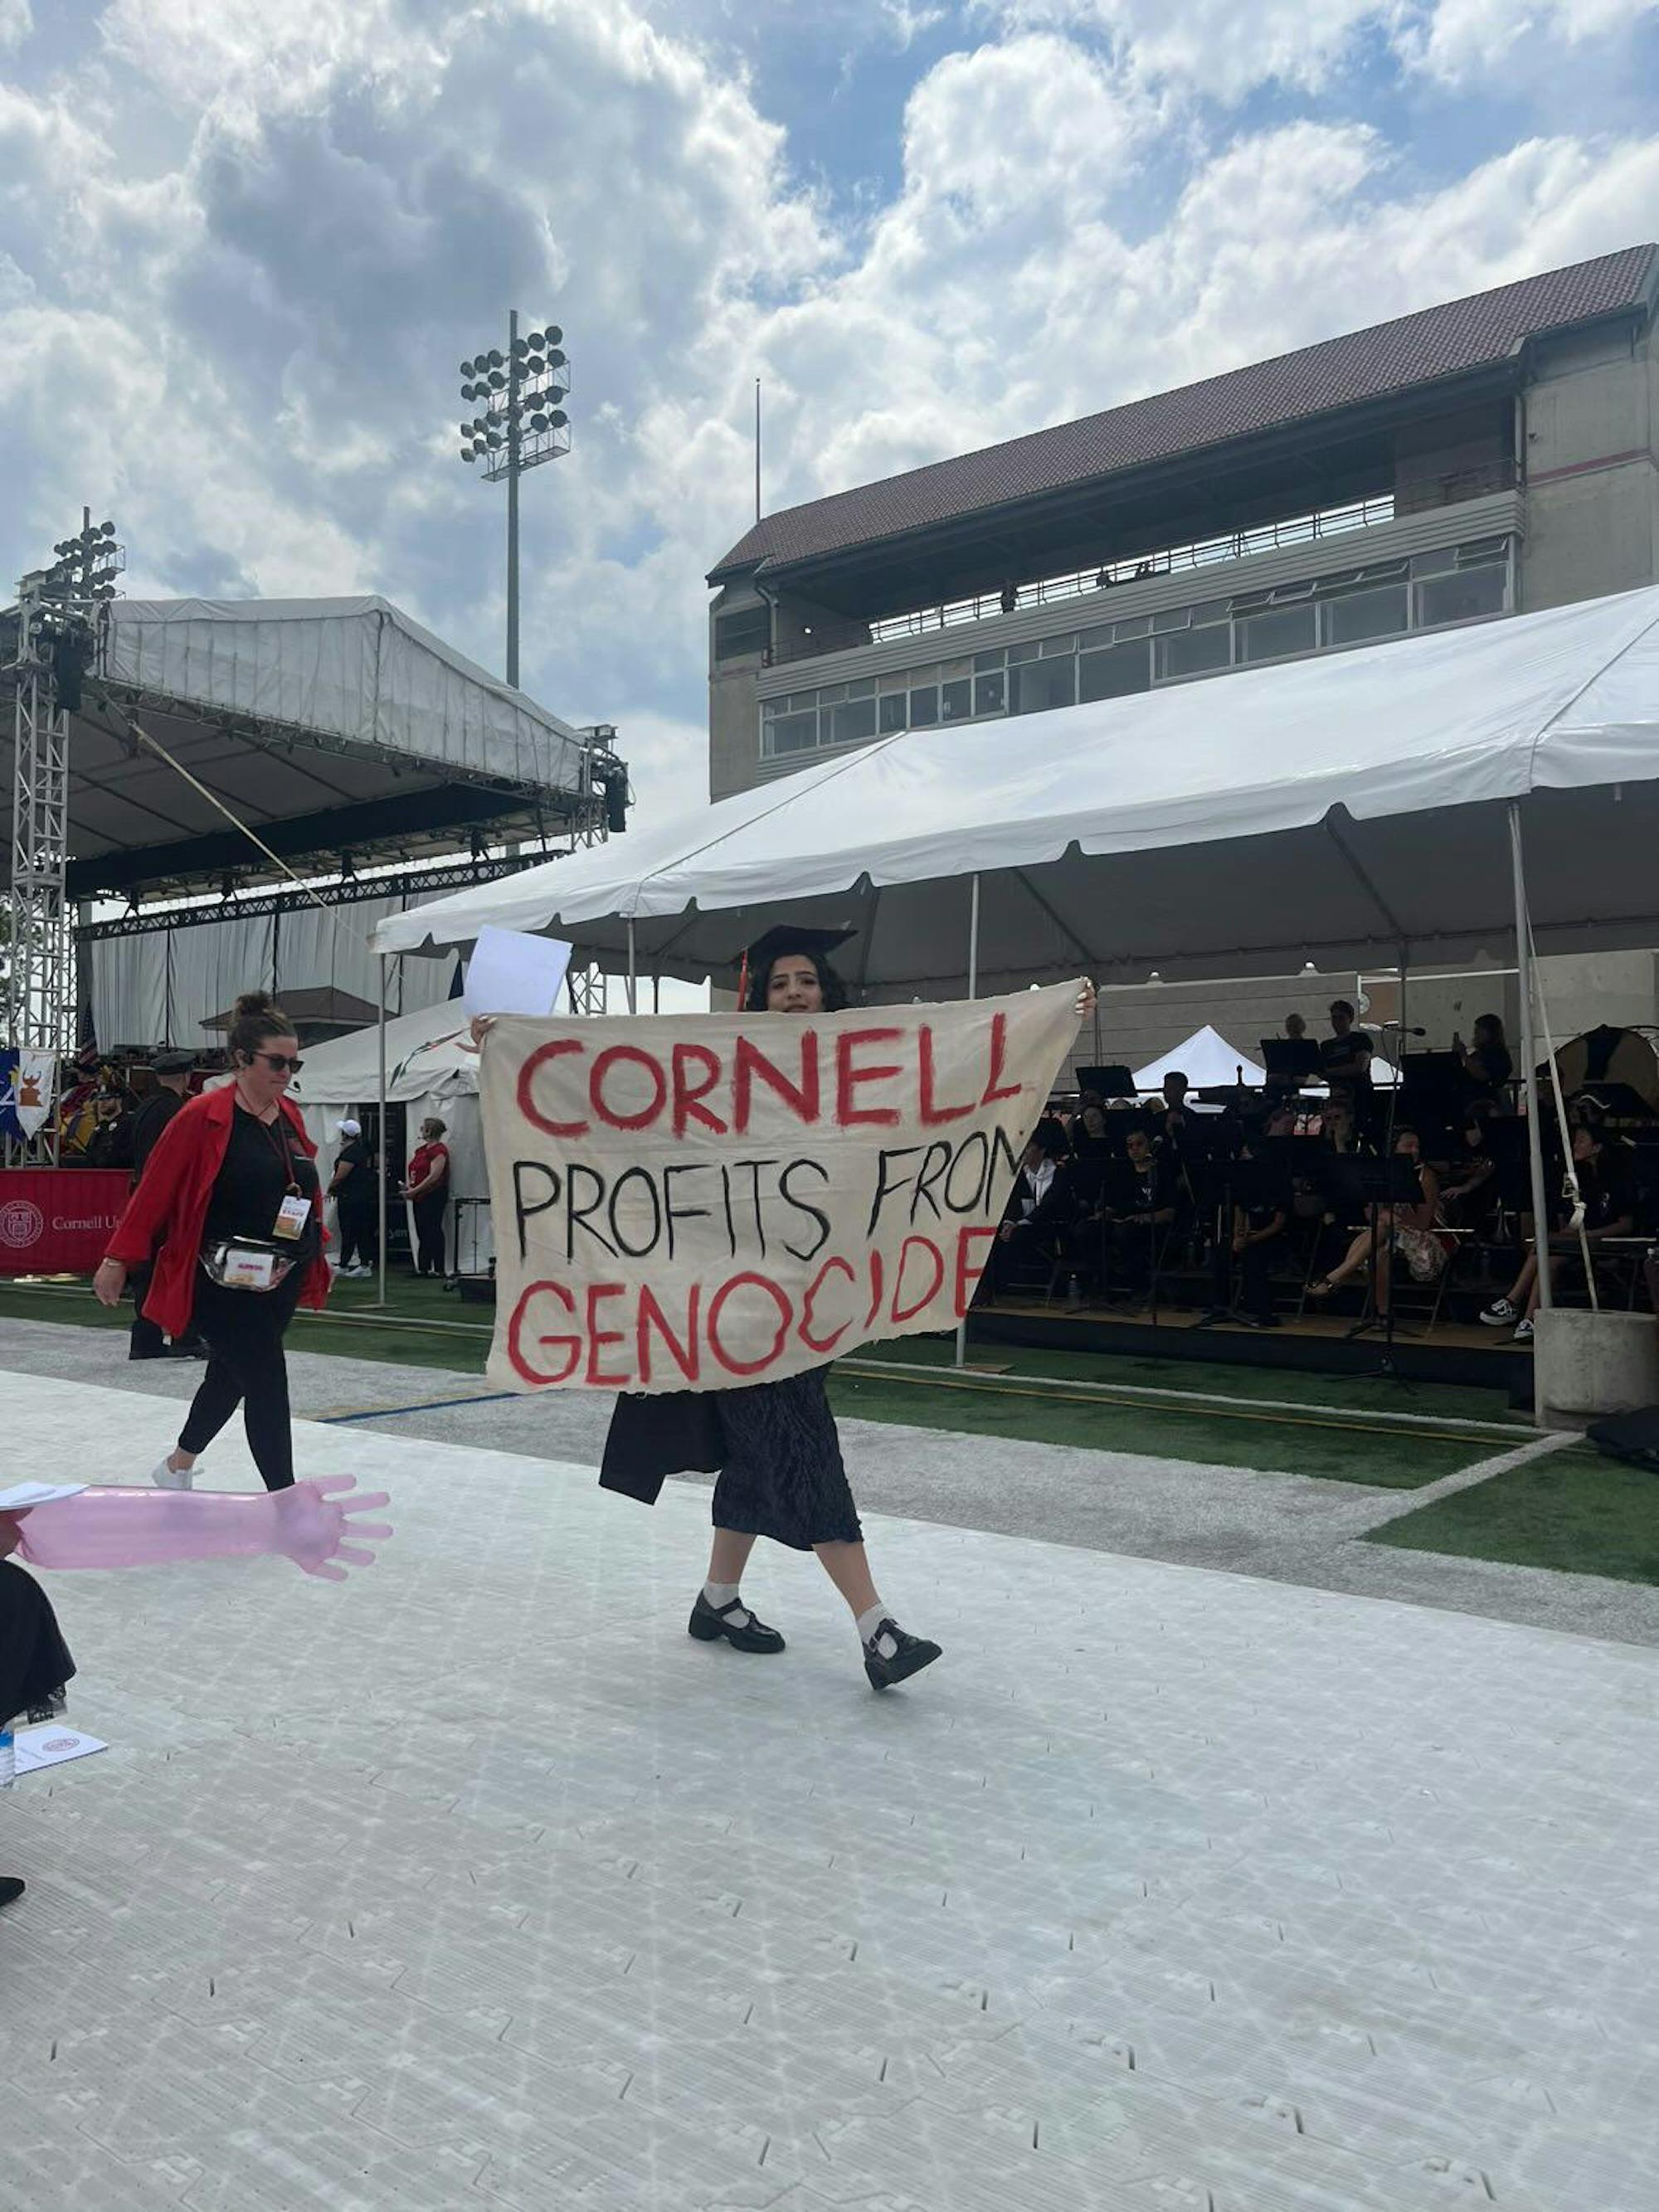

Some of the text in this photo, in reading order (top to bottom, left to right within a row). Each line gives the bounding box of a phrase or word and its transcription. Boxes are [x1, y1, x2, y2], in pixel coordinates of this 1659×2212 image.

[517, 1013, 1022, 1138] CORNELL
[52, 1215, 101, 1229] Cornell
[513, 1159, 830, 1262] PROFITS
[508, 1226, 998, 1385] GENOCIDE
